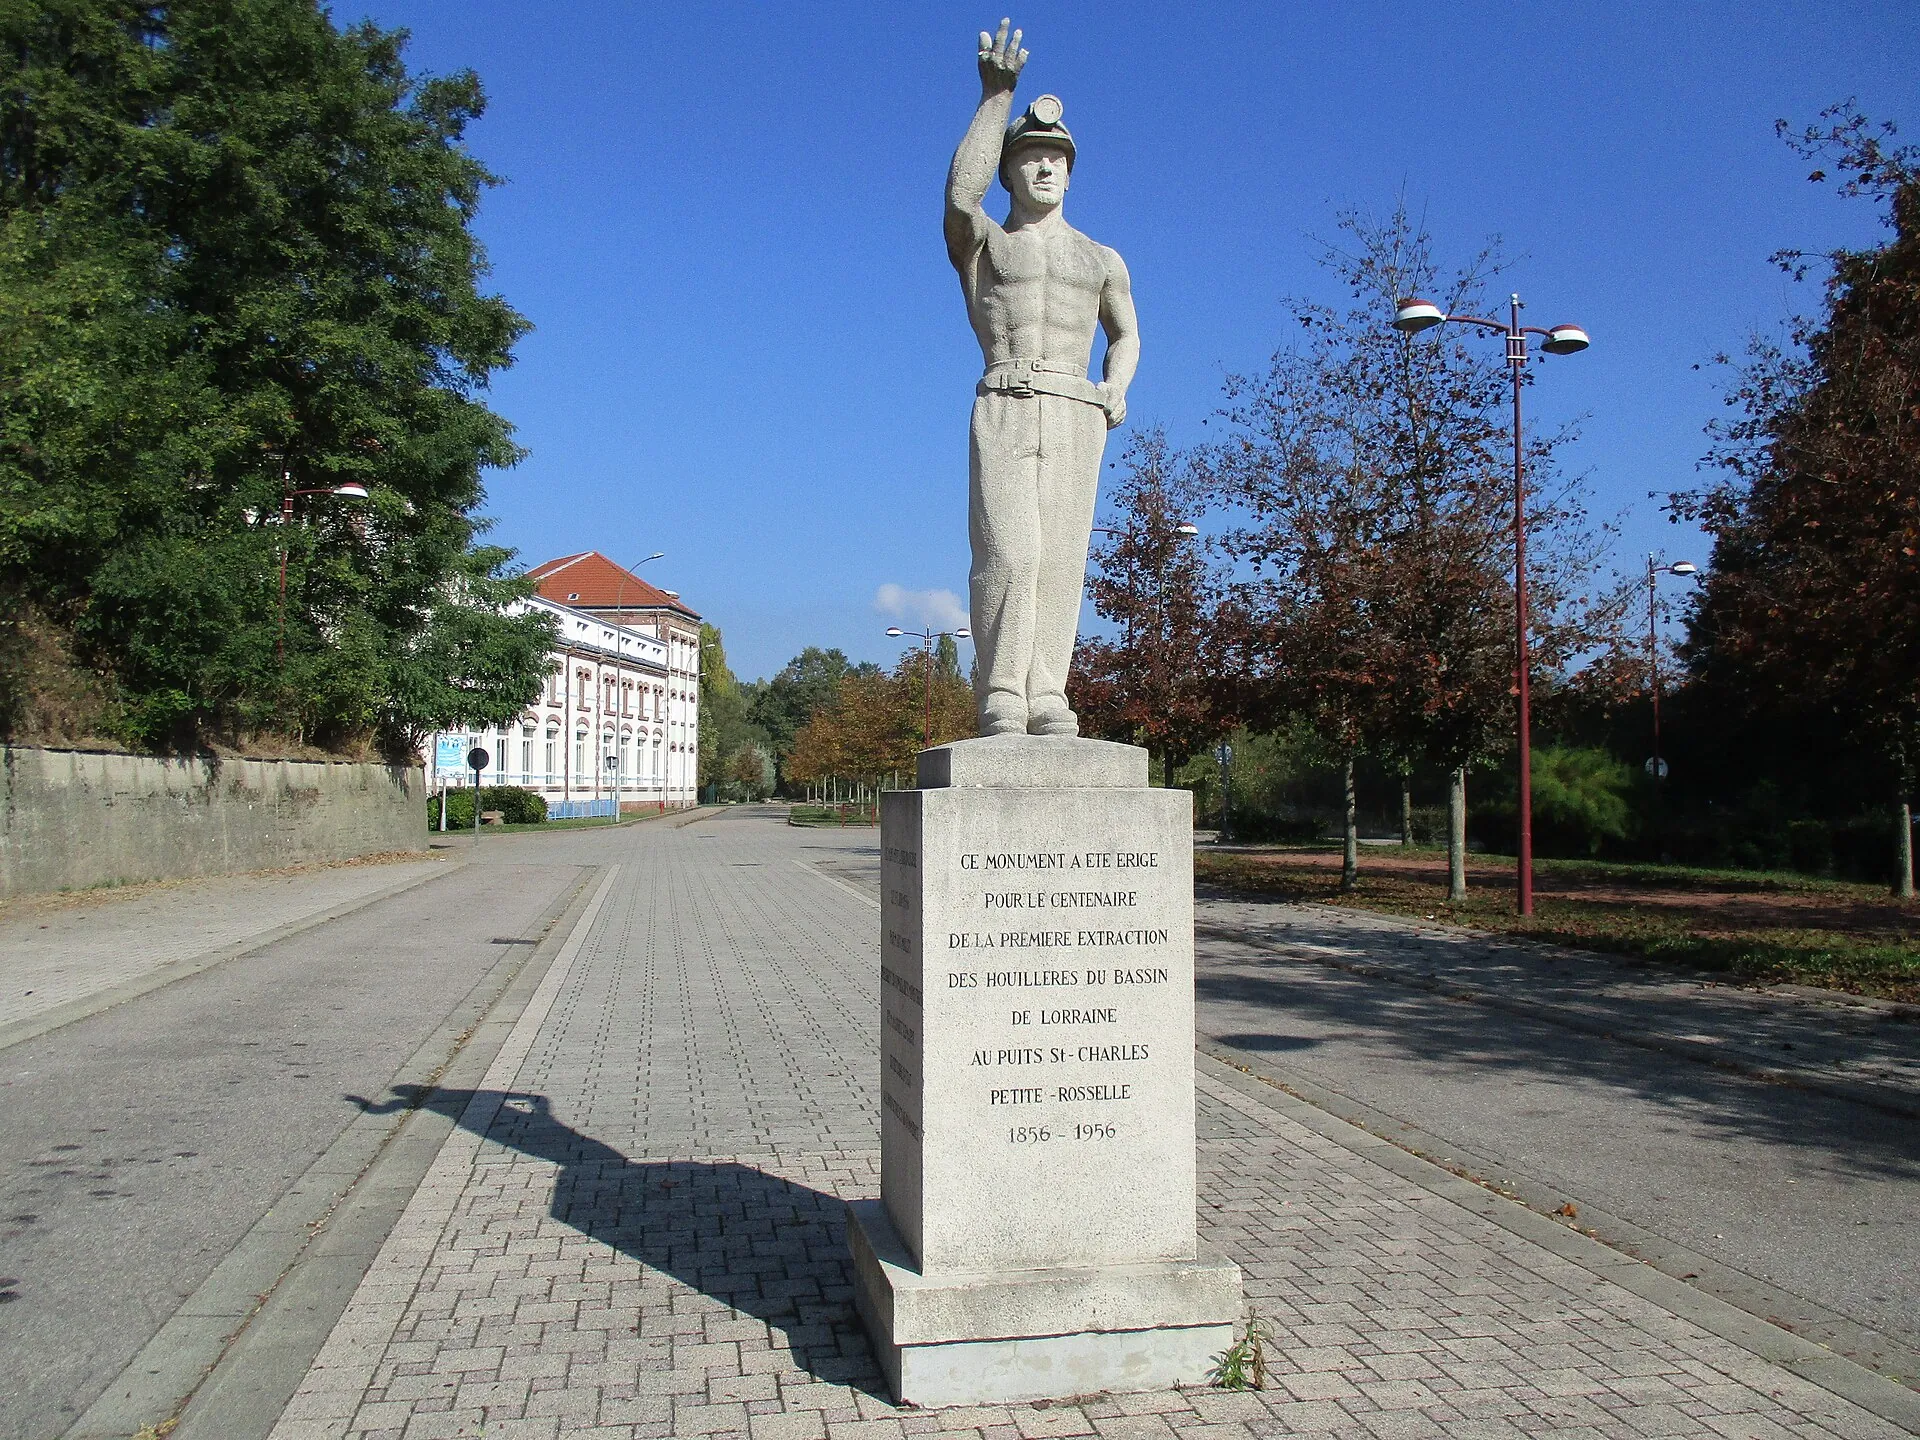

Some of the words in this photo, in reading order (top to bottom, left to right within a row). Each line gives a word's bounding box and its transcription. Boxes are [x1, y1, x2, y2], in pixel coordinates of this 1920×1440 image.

[961, 854, 979, 869] CE
[984, 853, 1065, 869] MONUMENT
[1070, 854, 1081, 869] A
[1086, 853, 1111, 868] ETE
[1116, 852, 1158, 868] ERIGE
[985, 893, 1023, 908] POUR
[1028, 893, 1045, 908] LE
[1051, 892, 1137, 907] CENTENAIRE
[949, 933, 970, 949] DE
[975, 933, 995, 948] LA
[1000, 931, 1072, 947] PREMIERE
[1077, 929, 1169, 946] EXTRACTION
[948, 973, 978, 988] DES
[986, 970, 1078, 987] HOUILLERES
[1086, 970, 1106, 985] DU
[1114, 968, 1168, 984] BASSIN
[1012, 1010, 1031, 1025] DE
[1041, 1008, 1117, 1025] LORRAINE
[971, 1050, 992, 1066] AU
[997, 1048, 1043, 1065] PUITS
[990, 1088, 1043, 1105] PETITE
[1008, 1125, 1050, 1144] 1856
[1074, 1122, 1116, 1142] 1956
